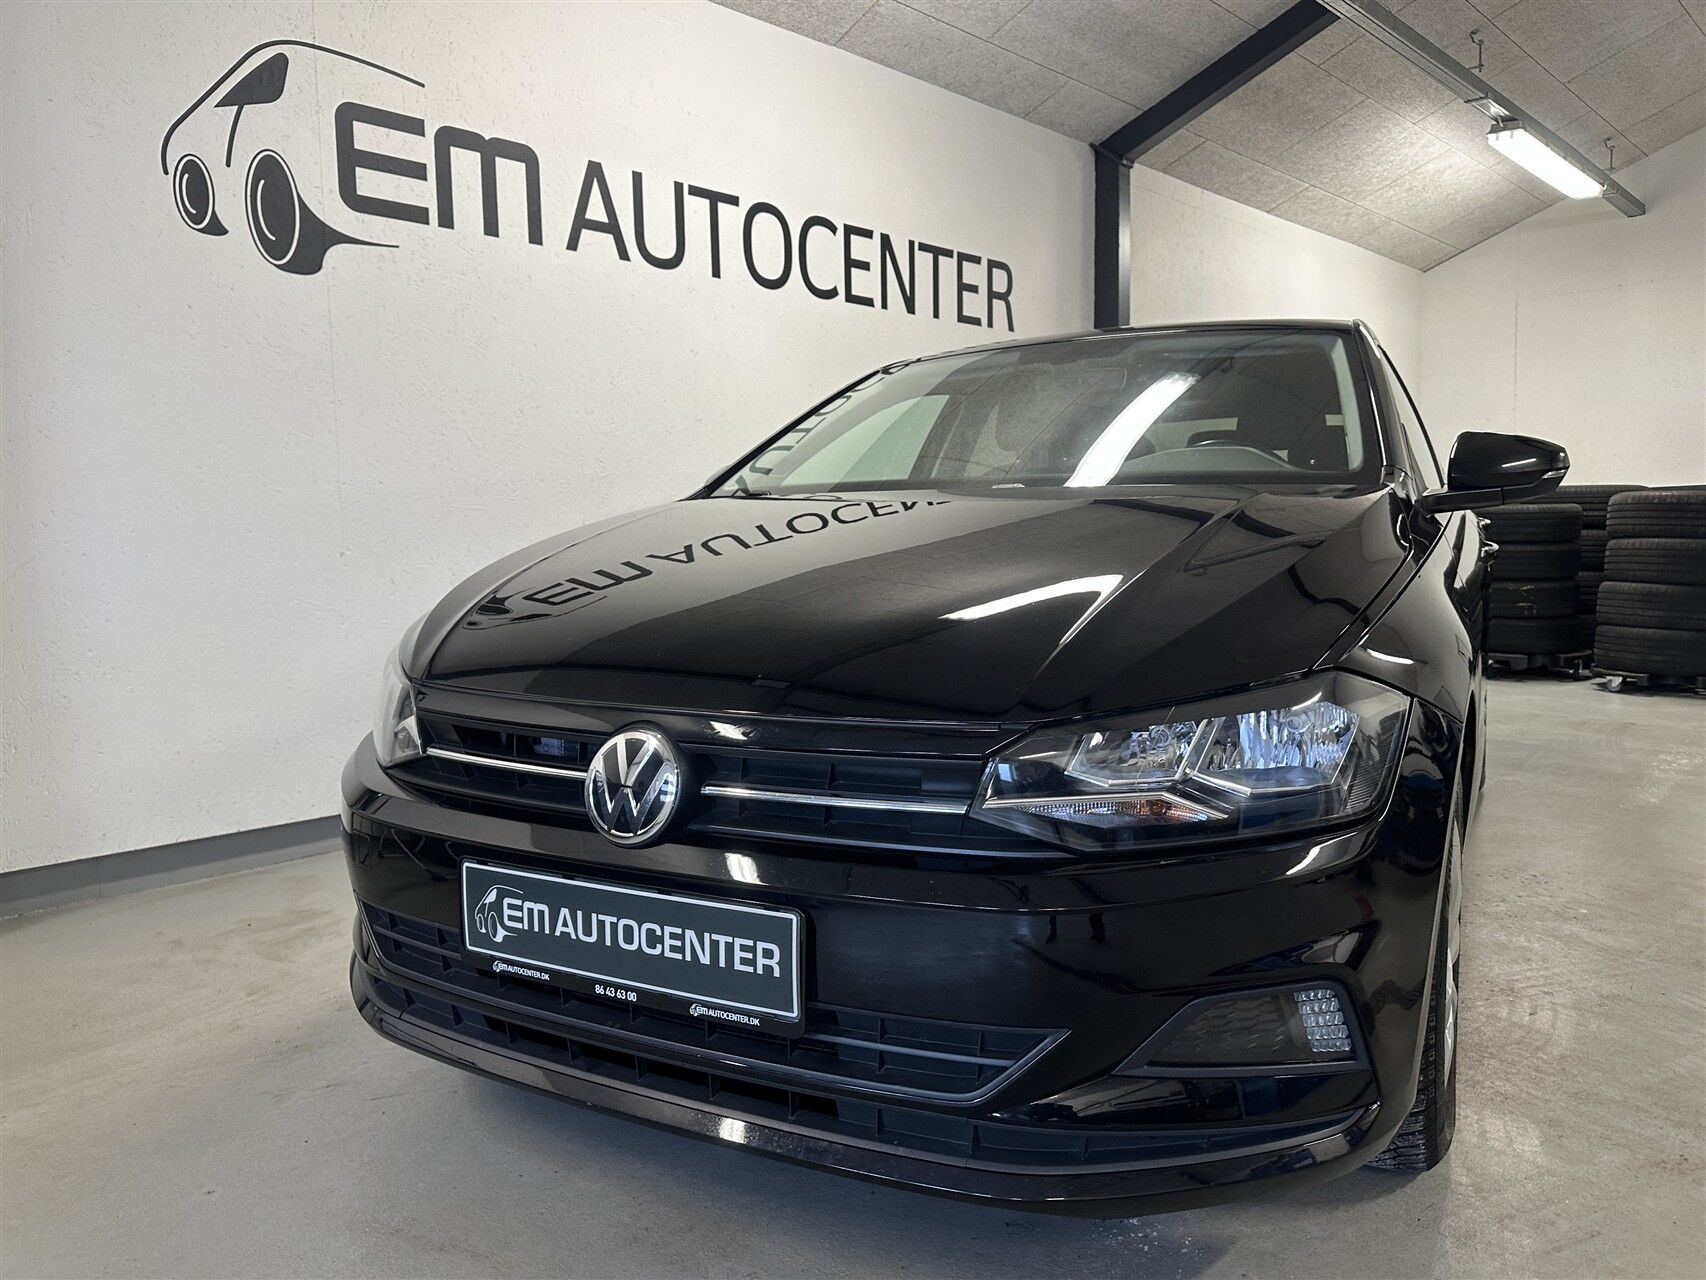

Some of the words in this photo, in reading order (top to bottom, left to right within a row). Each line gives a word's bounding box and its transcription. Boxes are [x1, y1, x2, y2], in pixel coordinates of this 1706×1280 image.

[566, 159, 1016, 333] AUTOCENTER
[554, 907, 781, 978] AUTOCENTER
[594, 984, 605, 995] 86
[605, 986, 616, 997] 43
[616, 989, 626, 1000] 63
[627, 991, 637, 1002] 00
